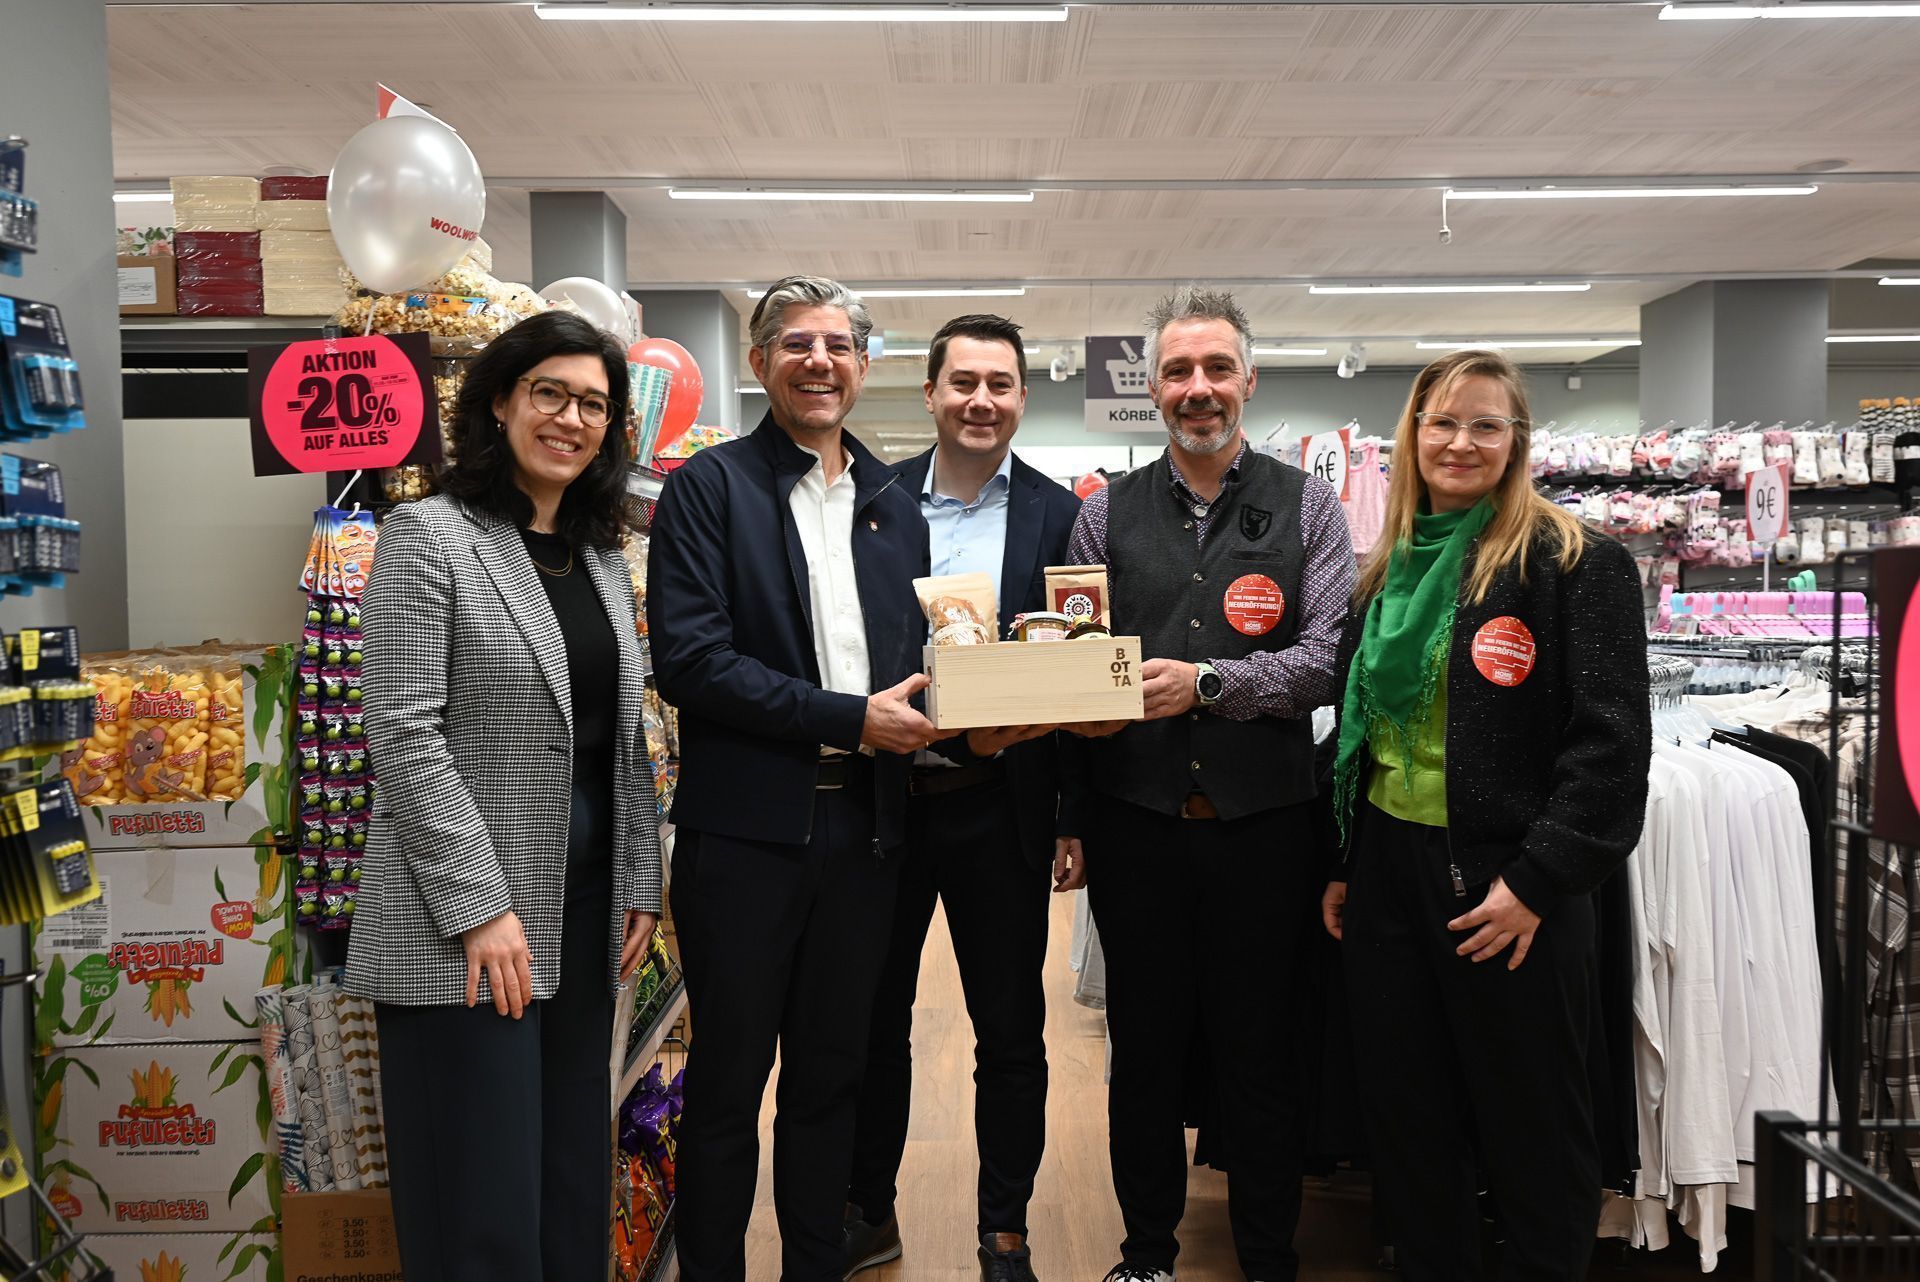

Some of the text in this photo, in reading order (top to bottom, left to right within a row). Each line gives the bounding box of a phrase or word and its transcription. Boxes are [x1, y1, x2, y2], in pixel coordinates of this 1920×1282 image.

[302, 350, 377, 374] AKTION
[287, 374, 400, 432] -20%
[1109, 407, 1157, 421] KÖRBE
[304, 435, 335, 451] AUF
[1314, 450, 1337, 483] 6€
[1756, 486, 1776, 521] 9€
[1116, 648, 1126, 660] B
[1110, 661, 1131, 673] OT
[1112, 675, 1132, 687] TA
[131, 699, 197, 721] fuletti
[109, 811, 205, 836] Pufuletti
[107, 938, 224, 970] Pufuletti
[99, 1117, 216, 1149] Pufuletti
[115, 1199, 209, 1223] Pufuletti
[296, 1269, 404, 1282] Geschenkpapie
